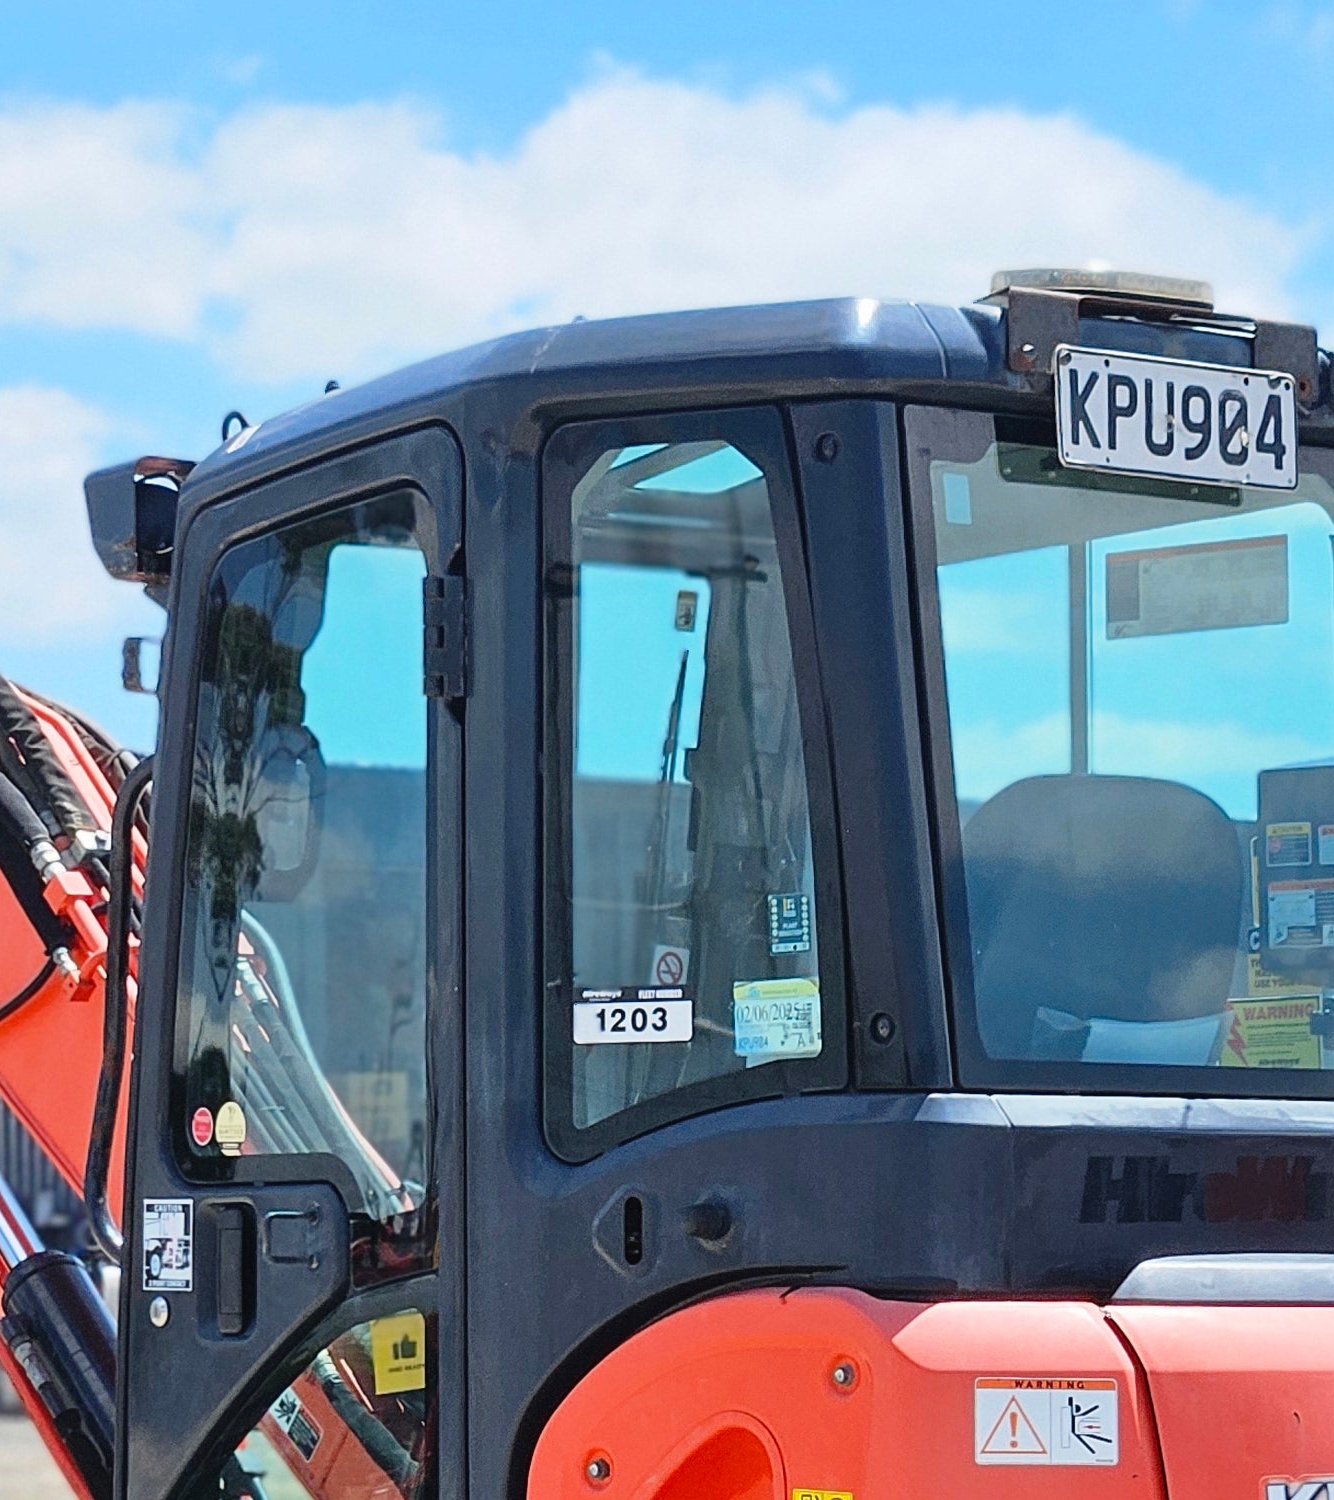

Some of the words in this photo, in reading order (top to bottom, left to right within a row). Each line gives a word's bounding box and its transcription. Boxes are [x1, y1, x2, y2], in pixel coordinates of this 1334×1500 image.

[1068, 369, 1287, 471] KPU904
[596, 1007, 668, 1032] 1203
[1014, 1380, 1084, 1389] WARNING
